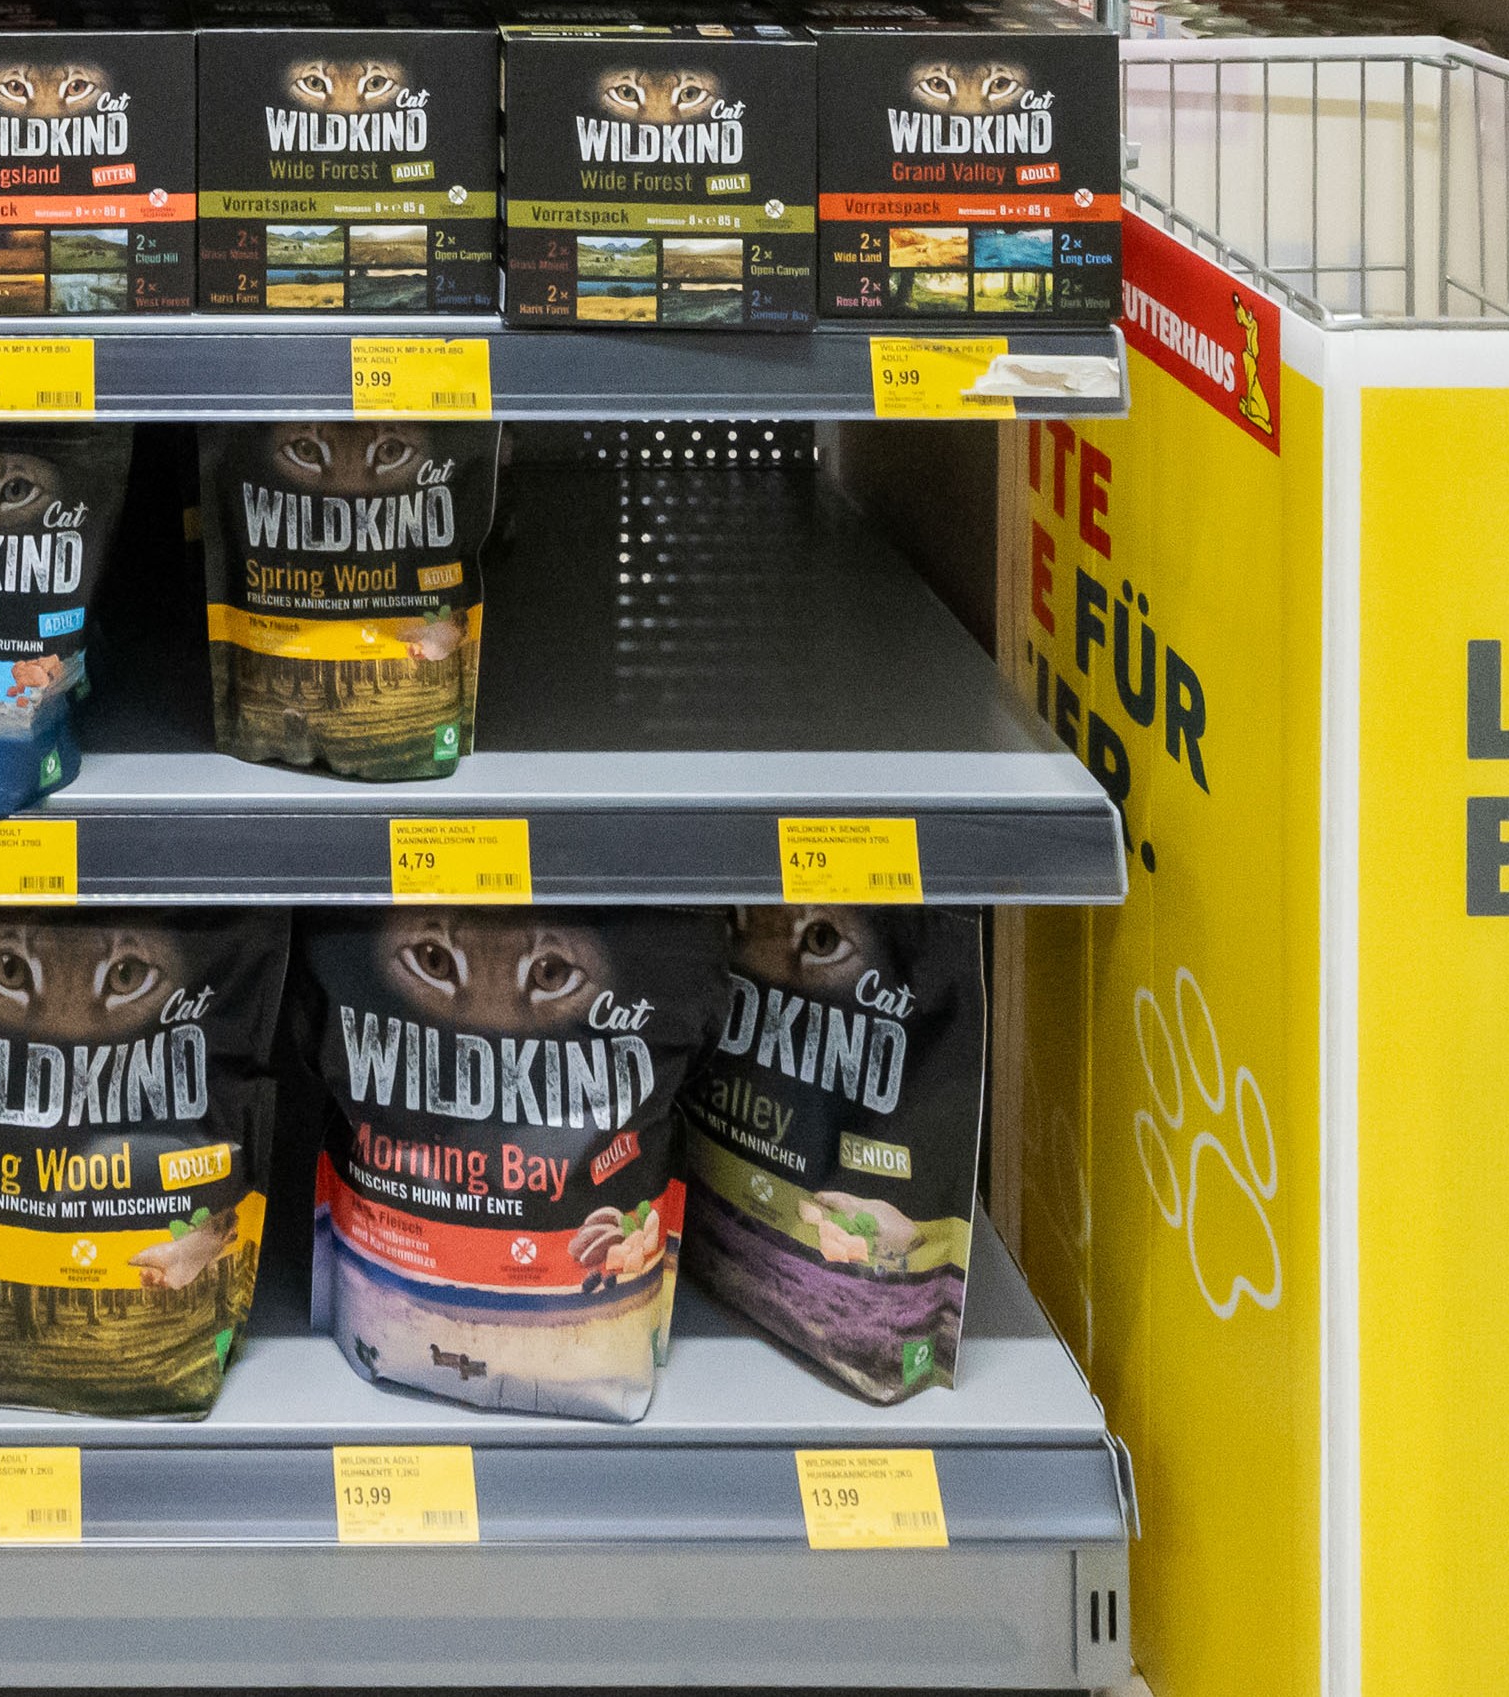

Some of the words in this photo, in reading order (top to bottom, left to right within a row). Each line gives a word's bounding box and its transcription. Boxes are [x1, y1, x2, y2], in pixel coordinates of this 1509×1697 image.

[97, 92, 130, 112] Cat
[94, 167, 133, 182] KITTEN
[269, 159, 315, 181] Wide
[322, 158, 378, 180] Forest
[395, 166, 431, 179] ADULT
[892, 161, 945, 182] Grand
[951, 162, 1006, 186] Valley
[245, 561, 324, 598] Spring
[333, 560, 397, 593] Wood
[1075, 565, 1210, 796] FÜR
[340, 1005, 655, 1131] WILDKIND
[35, 1142, 131, 1190] Wood
[167, 1153, 224, 1183] ADULT
[502, 1142, 570, 1201] Bay
[841, 1141, 908, 1173] SENIOR
[91, 1195, 192, 1215] WILDSCHWEIN
